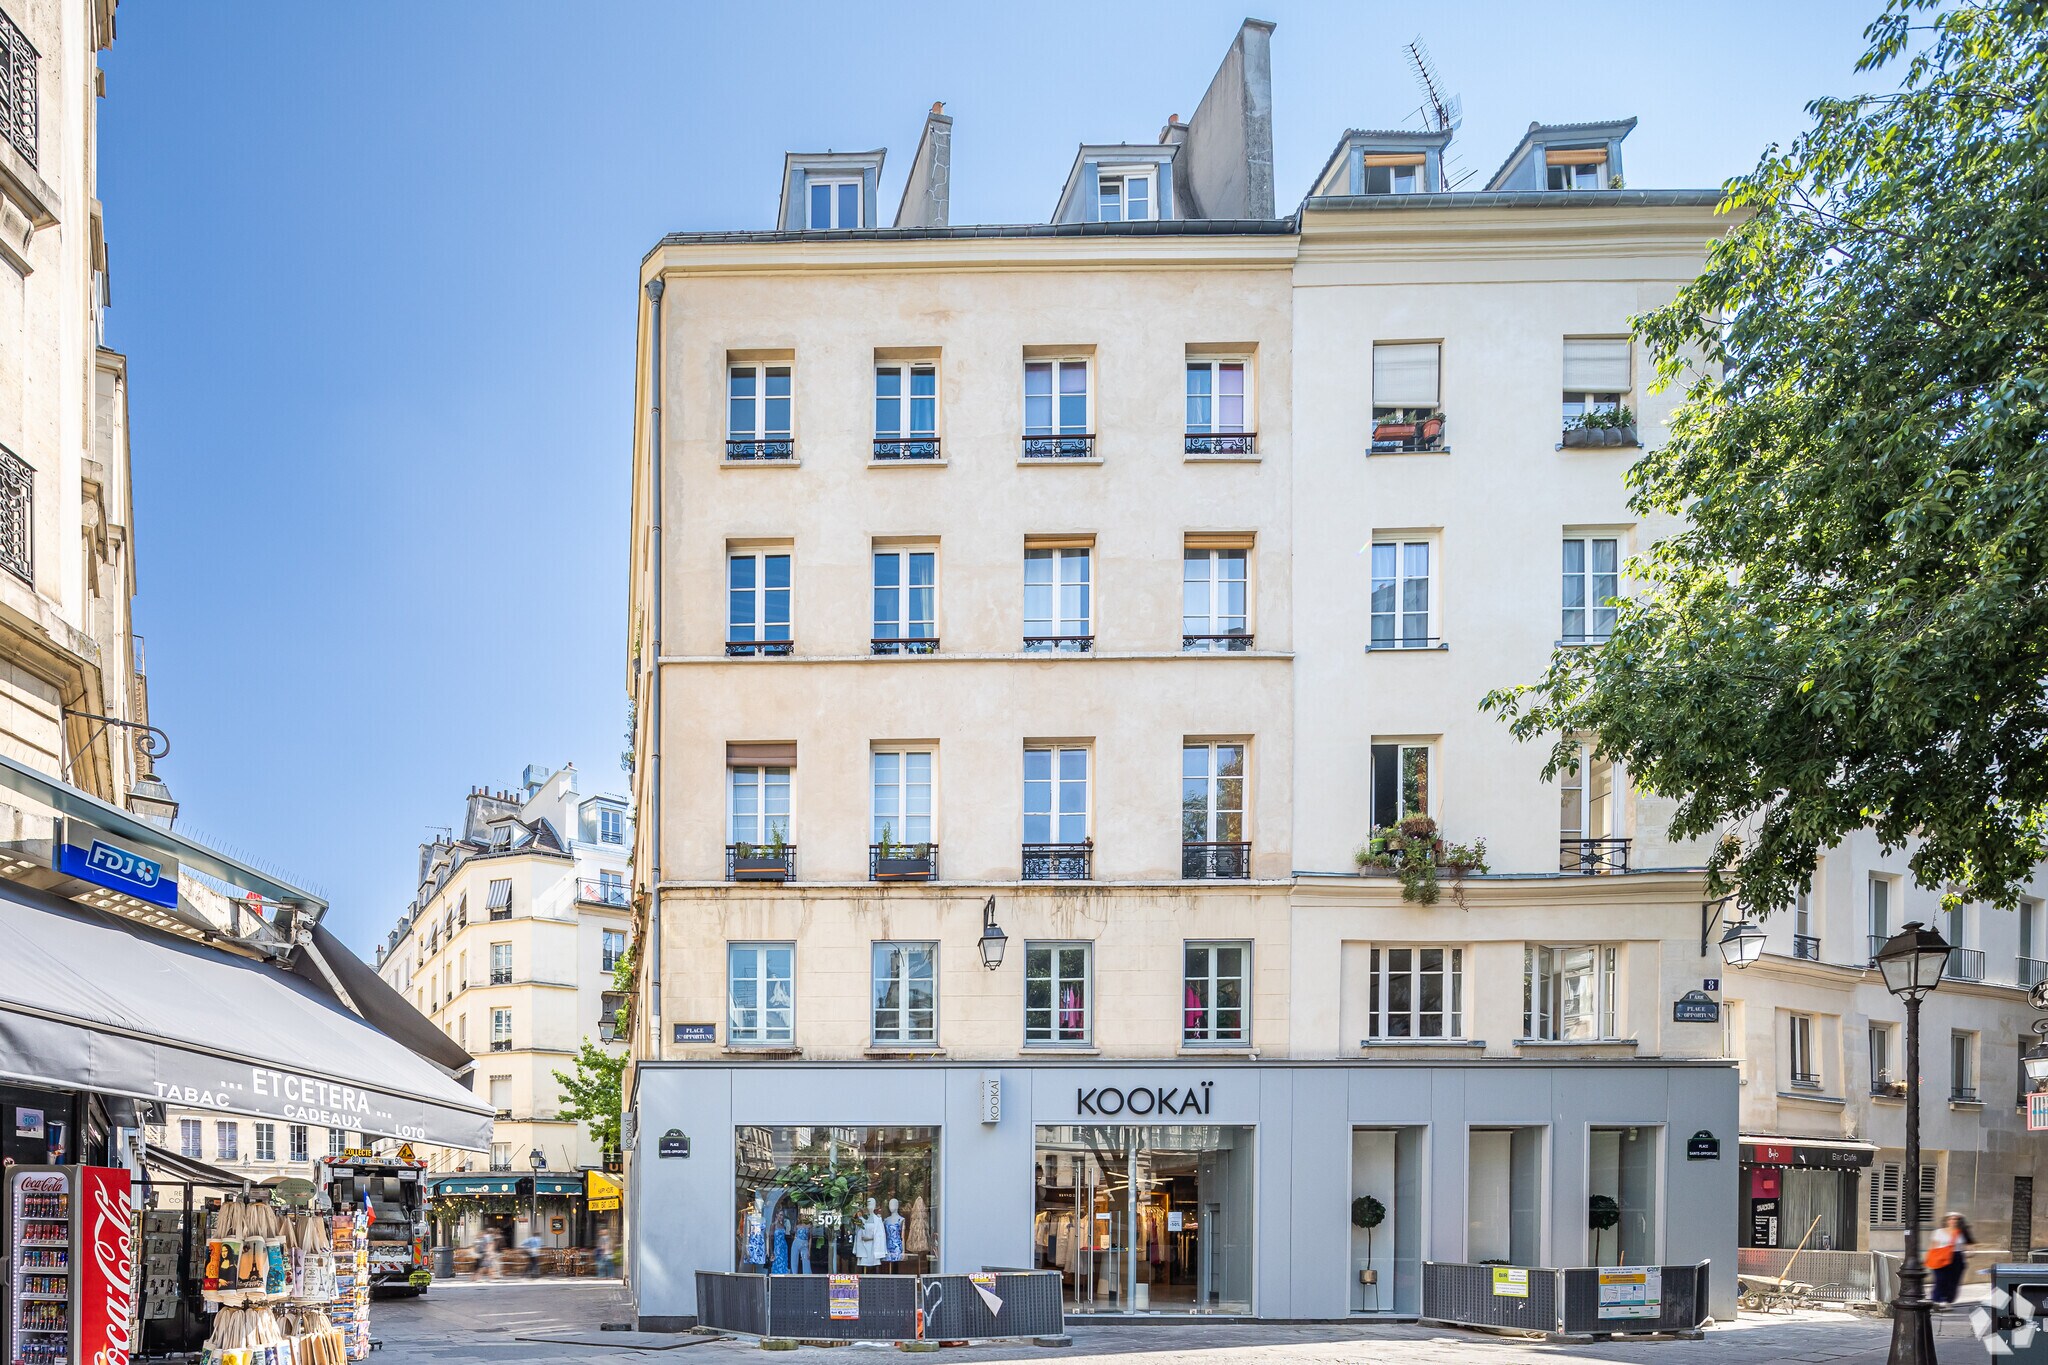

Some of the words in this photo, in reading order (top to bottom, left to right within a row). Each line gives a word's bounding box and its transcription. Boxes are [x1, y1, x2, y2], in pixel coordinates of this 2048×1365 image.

[93, 846, 134, 874] FDJ
[1708, 980, 1714, 990] 8
[153, 1081, 230, 1107] TABAC
[252, 1068, 370, 1115] ETCETERA
[989, 1079, 1000, 1121] KOOKAÏ
[1077, 1080, 1214, 1115] KOOKAÏ
[283, 1104, 362, 1129] CADEAUX
[395, 1124, 426, 1139] LOTO
[345, 1148, 373, 1157] COLLECTE
[1832, 1152, 1842, 1161] Bar
[21, 1176, 65, 1192] Coca-Cola
[814, 1214, 842, 1226] -50%
[93, 1174, 131, 1365] oca-Cola
